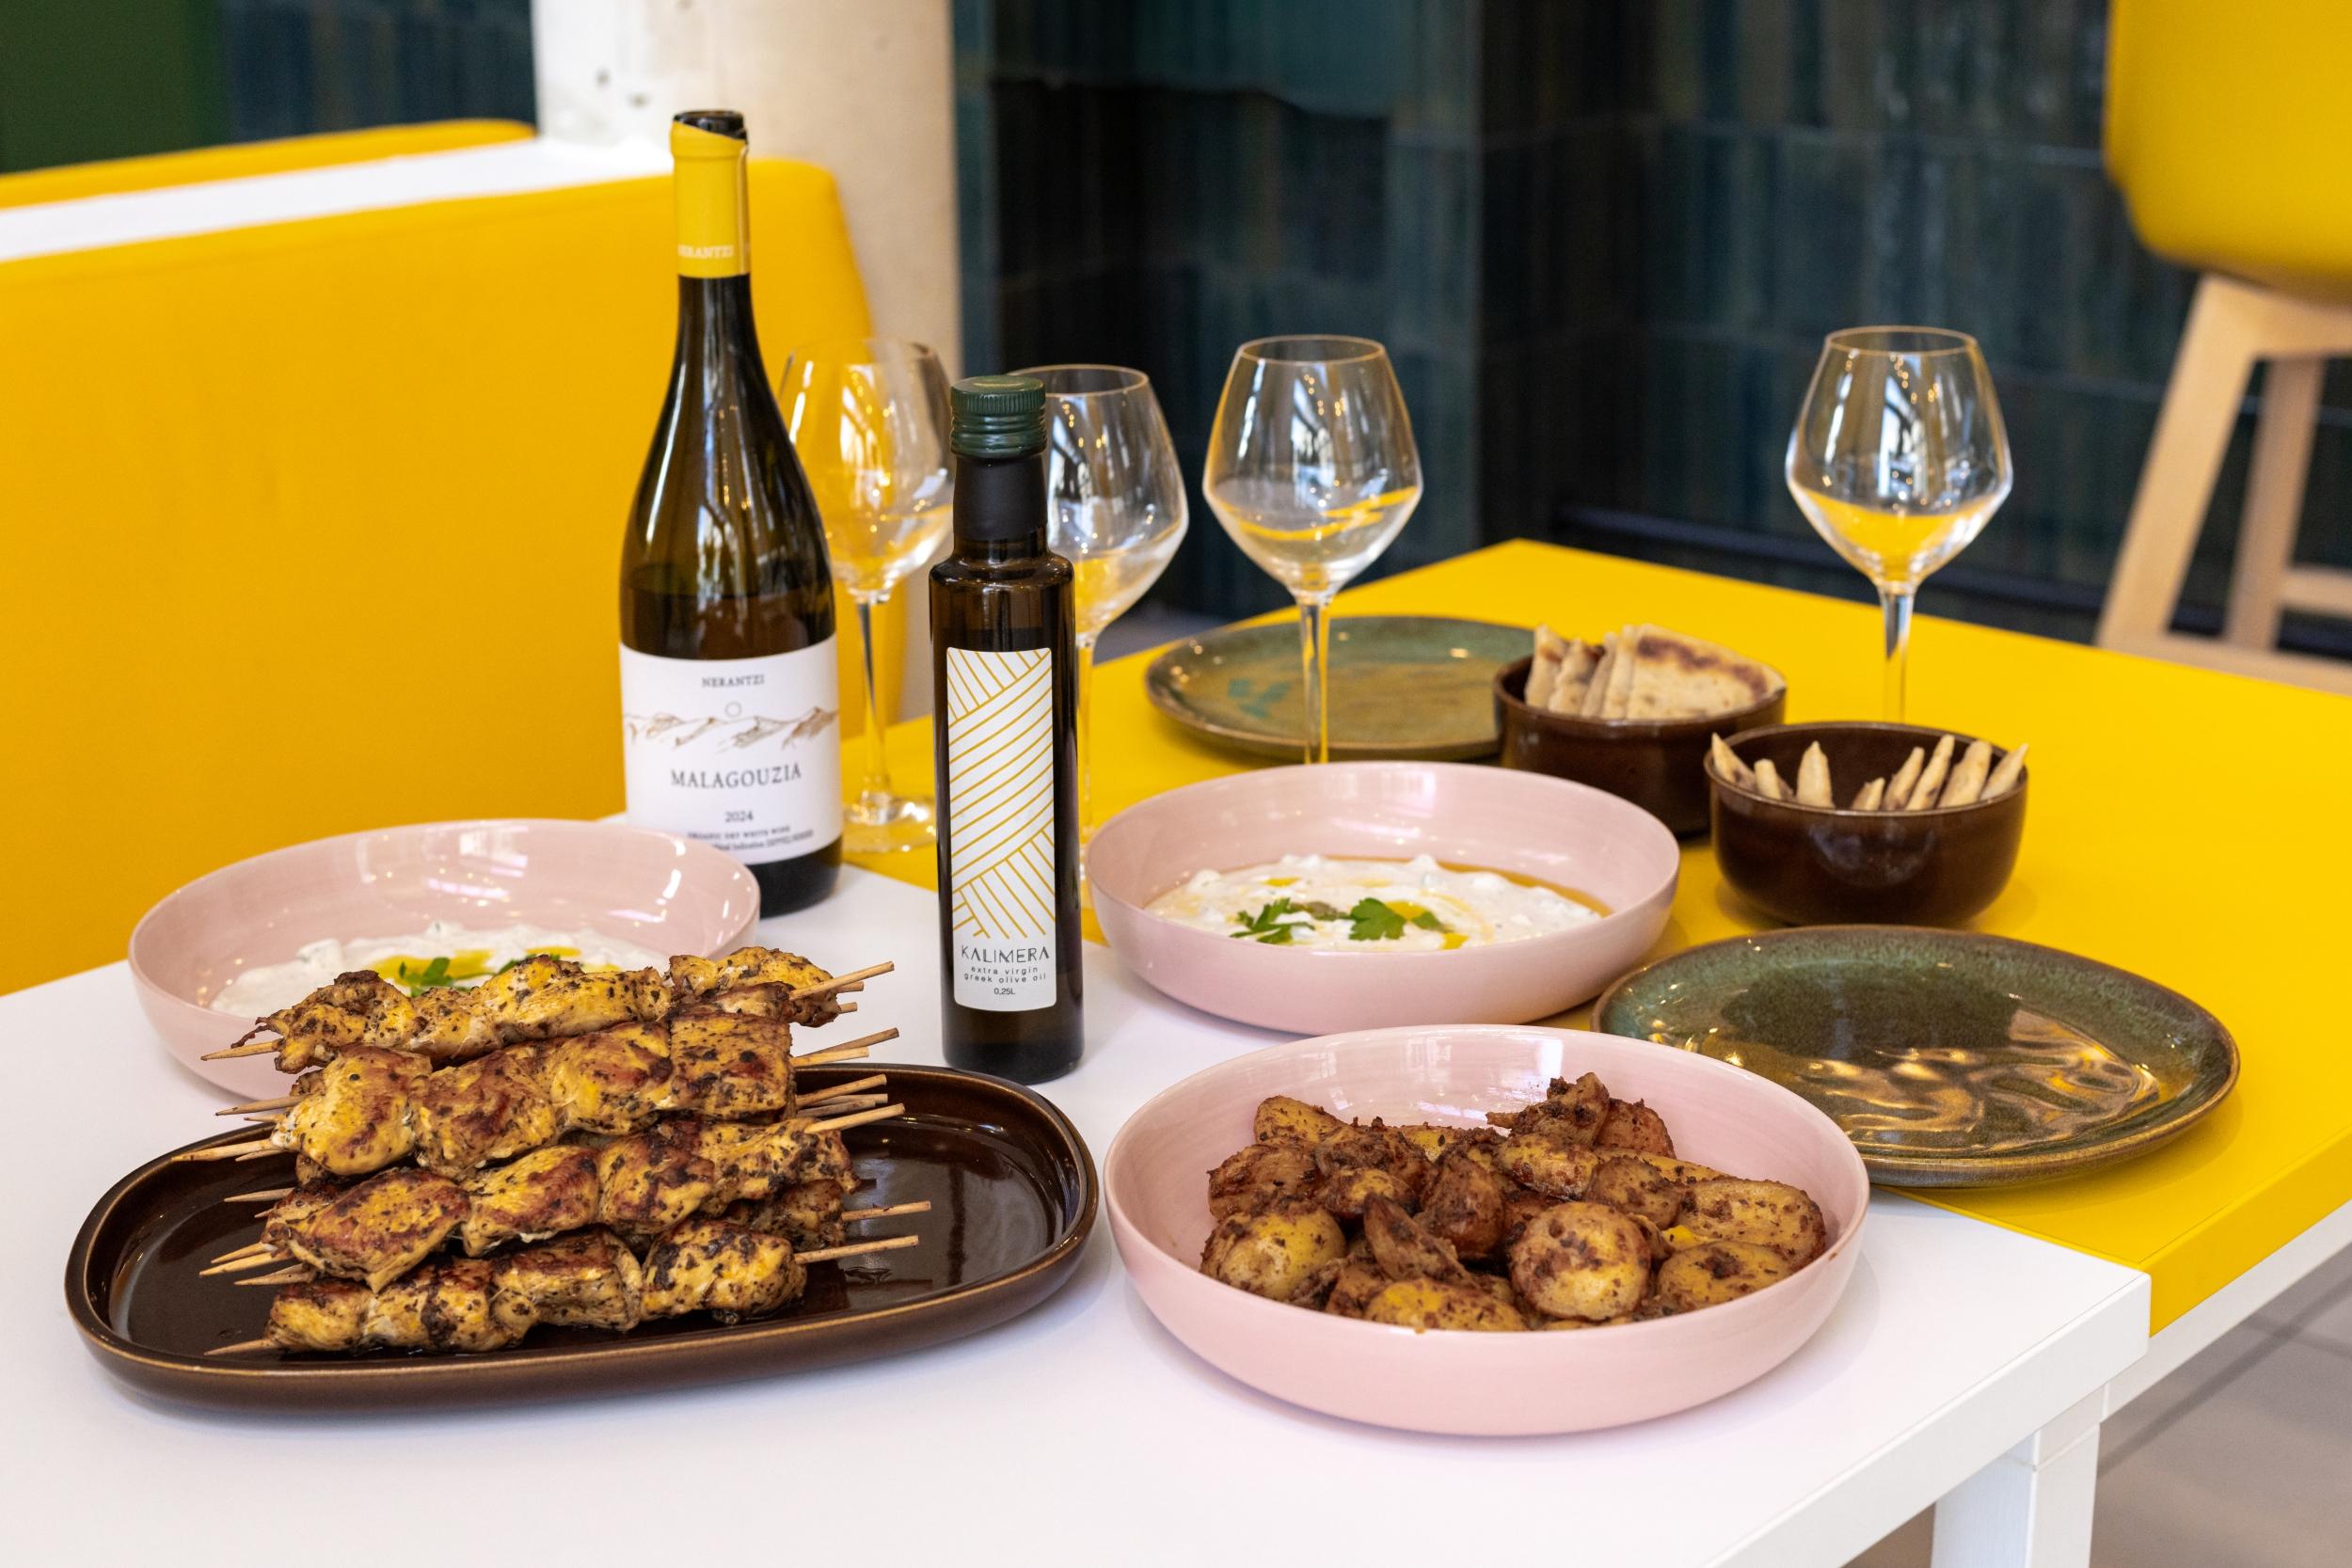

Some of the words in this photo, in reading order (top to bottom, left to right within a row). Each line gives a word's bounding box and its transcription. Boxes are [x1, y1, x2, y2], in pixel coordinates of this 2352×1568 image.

[702, 674, 765, 688] NERANTZI
[671, 763, 802, 788] MALAGOUZIA
[724, 810, 754, 823] 2024
[961, 944, 1050, 963] KALIMERA
[971, 966, 998, 974] extra
[1005, 965, 1038, 975] virgin
[964, 973, 993, 982] greek
[998, 975, 1027, 984] olive
[1032, 973, 1047, 982] oil
